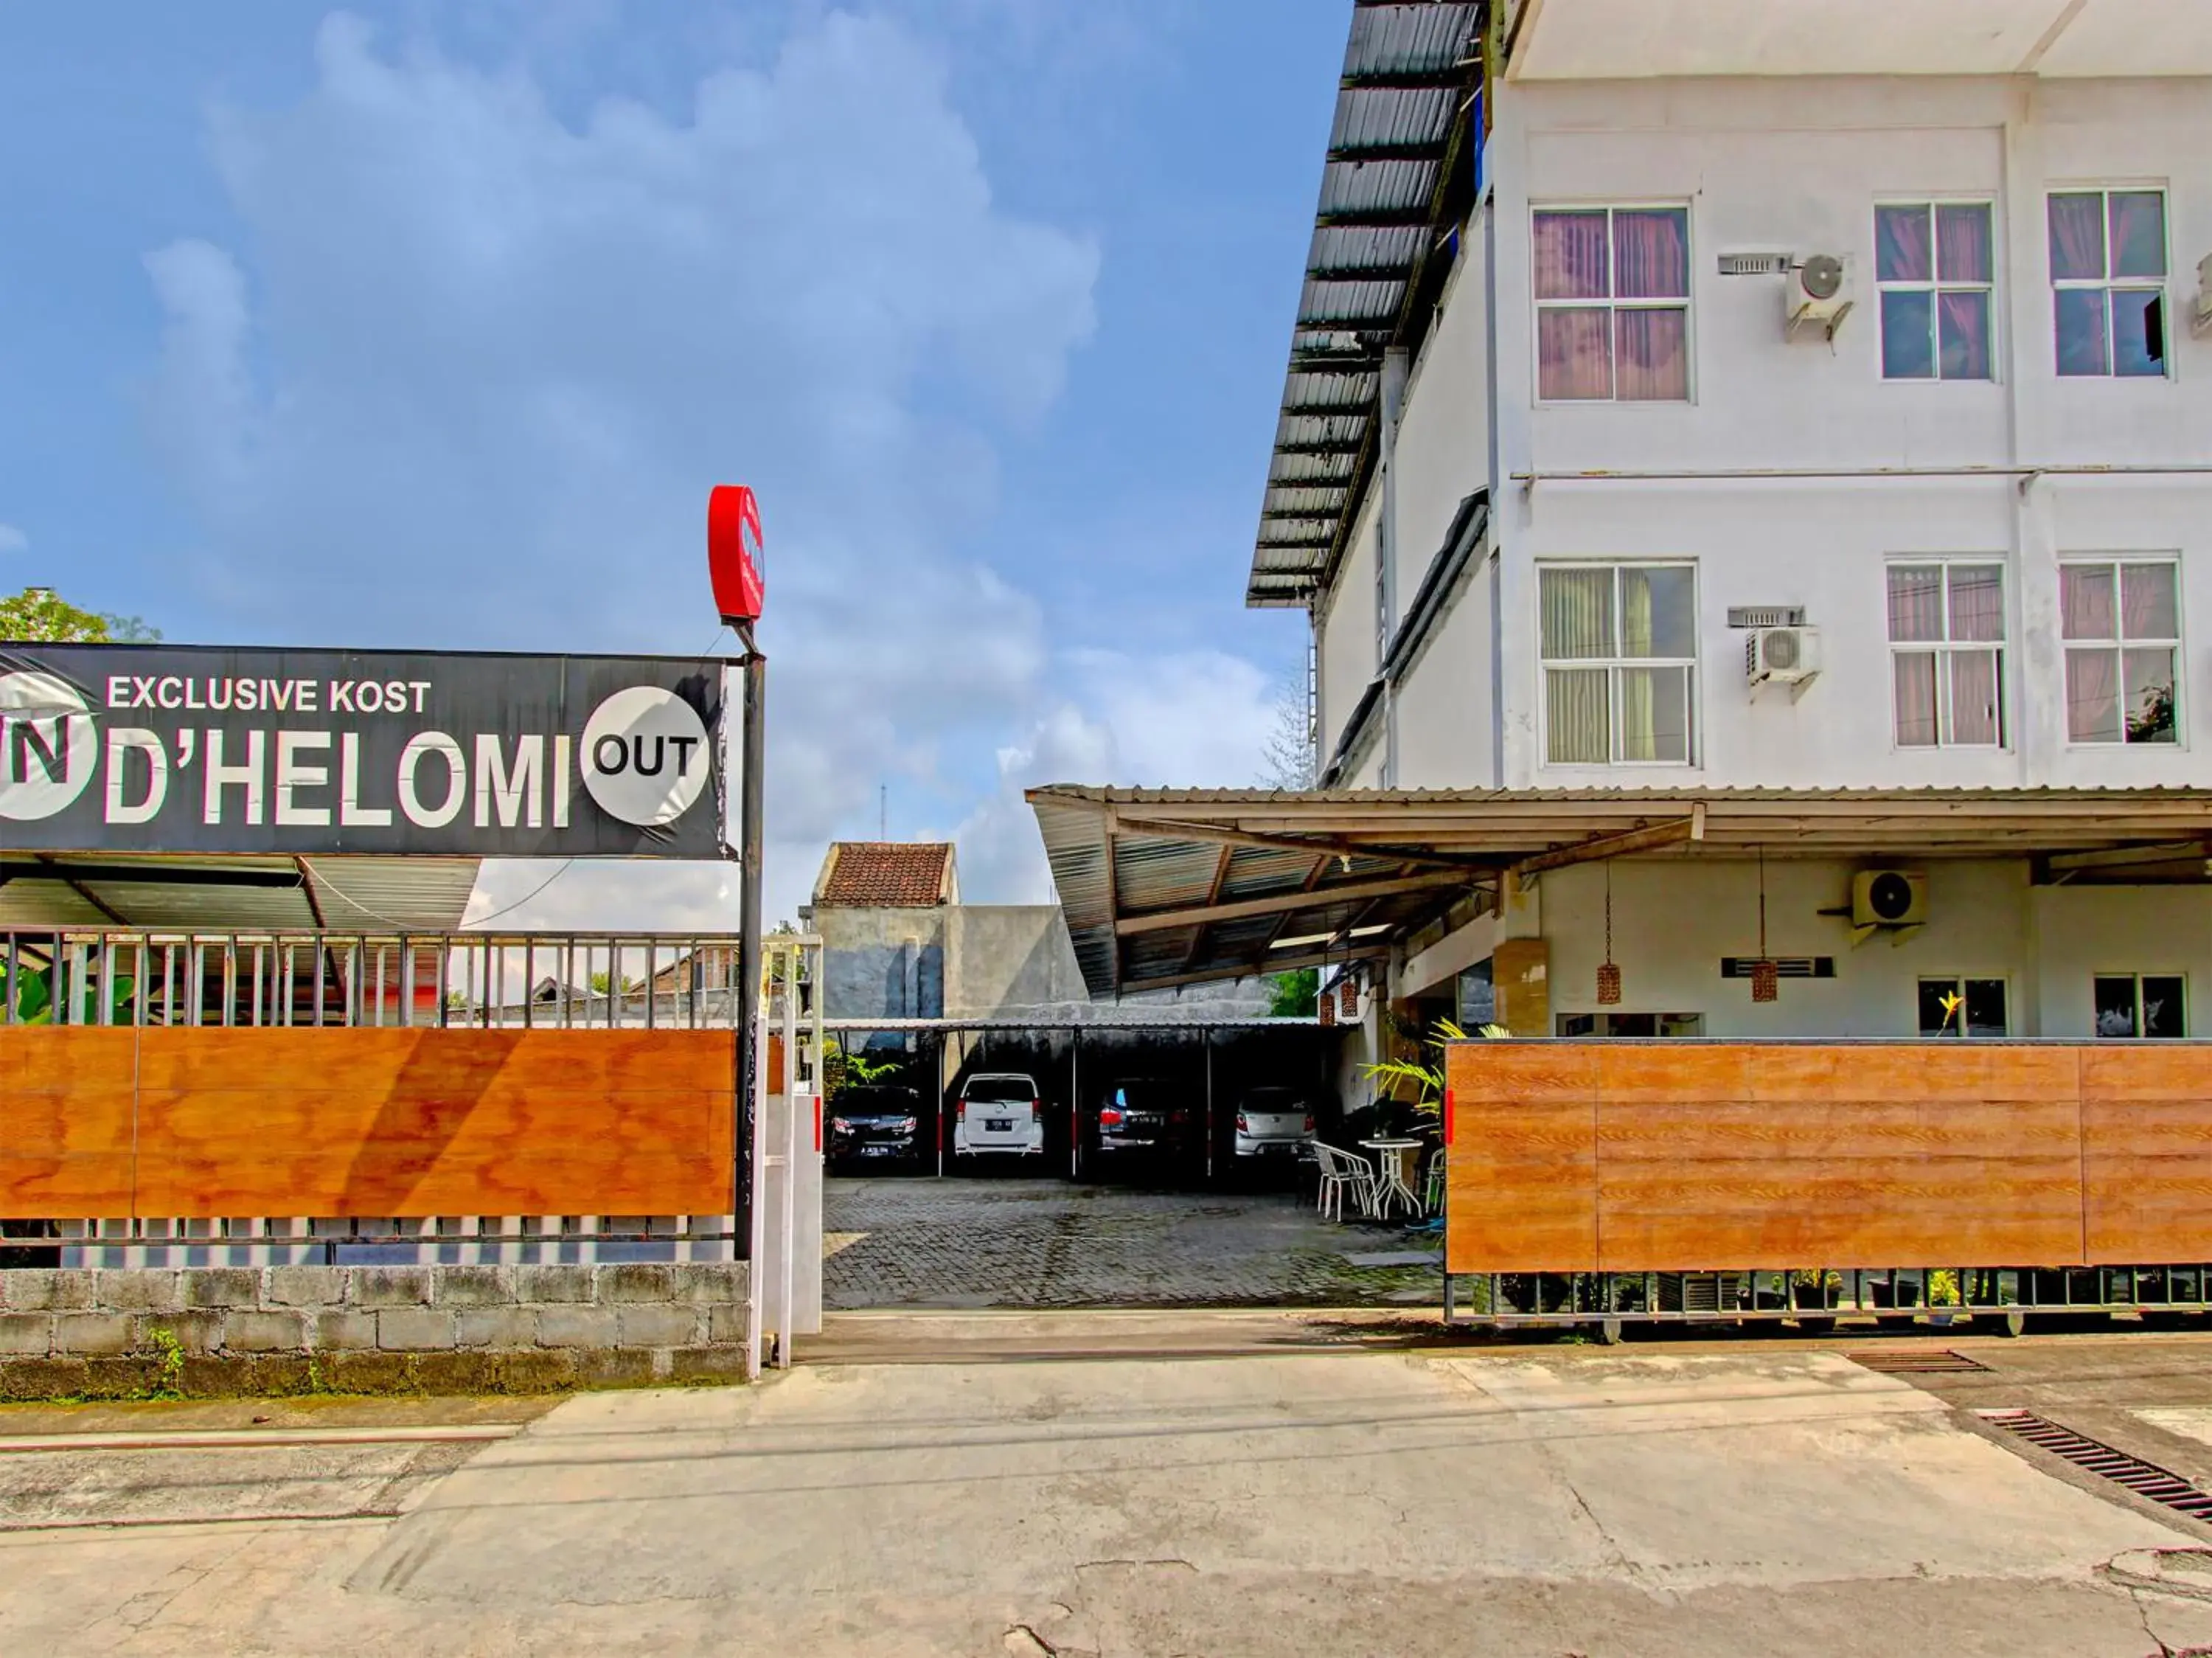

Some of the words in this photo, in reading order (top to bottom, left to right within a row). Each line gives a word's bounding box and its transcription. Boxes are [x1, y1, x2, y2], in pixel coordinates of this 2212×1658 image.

[106, 676, 318, 711] EXCLUSIVE
[330, 680, 431, 713] KOST
[594, 734, 698, 777] OUT
